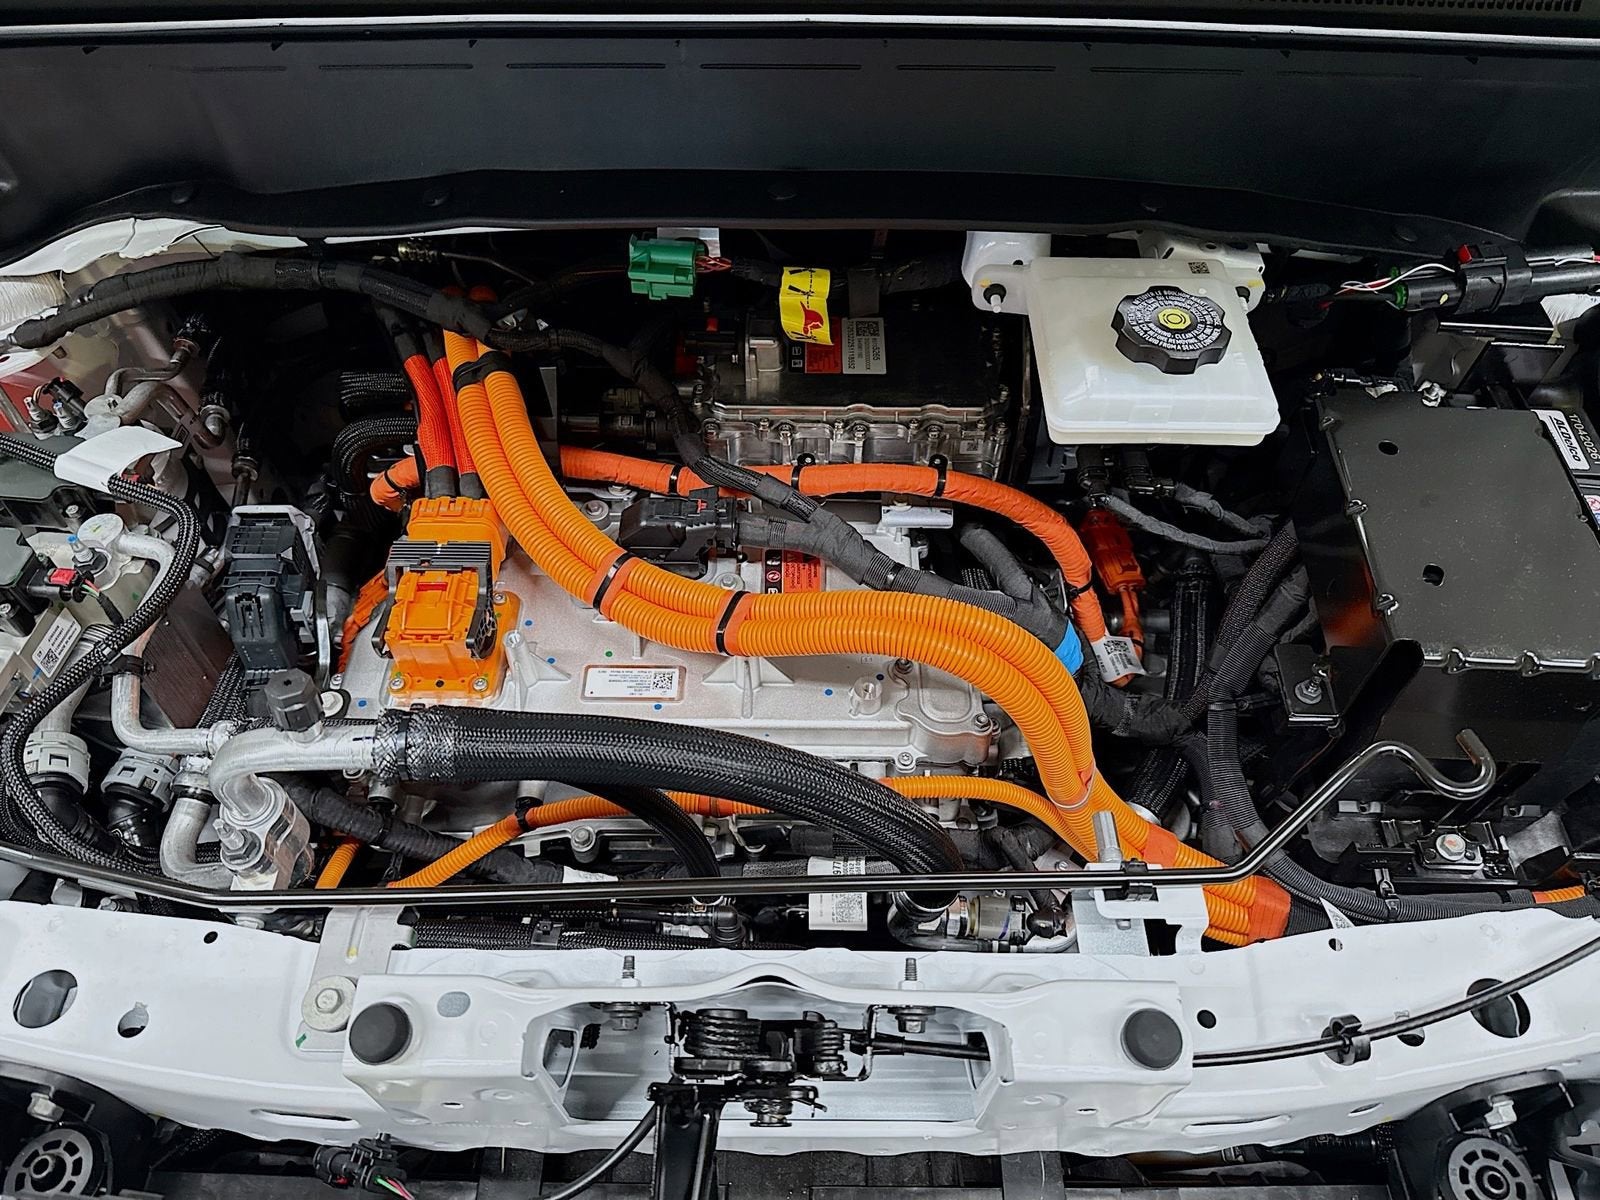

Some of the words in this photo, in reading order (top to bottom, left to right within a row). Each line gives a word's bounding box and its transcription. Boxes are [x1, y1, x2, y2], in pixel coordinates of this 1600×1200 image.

[1143, 334, 1160, 344] FLUID
[1159, 341, 1176, 350] FROM
[1182, 342, 1203, 350] SEALED
[1553, 417, 1582, 462] ACDelco
